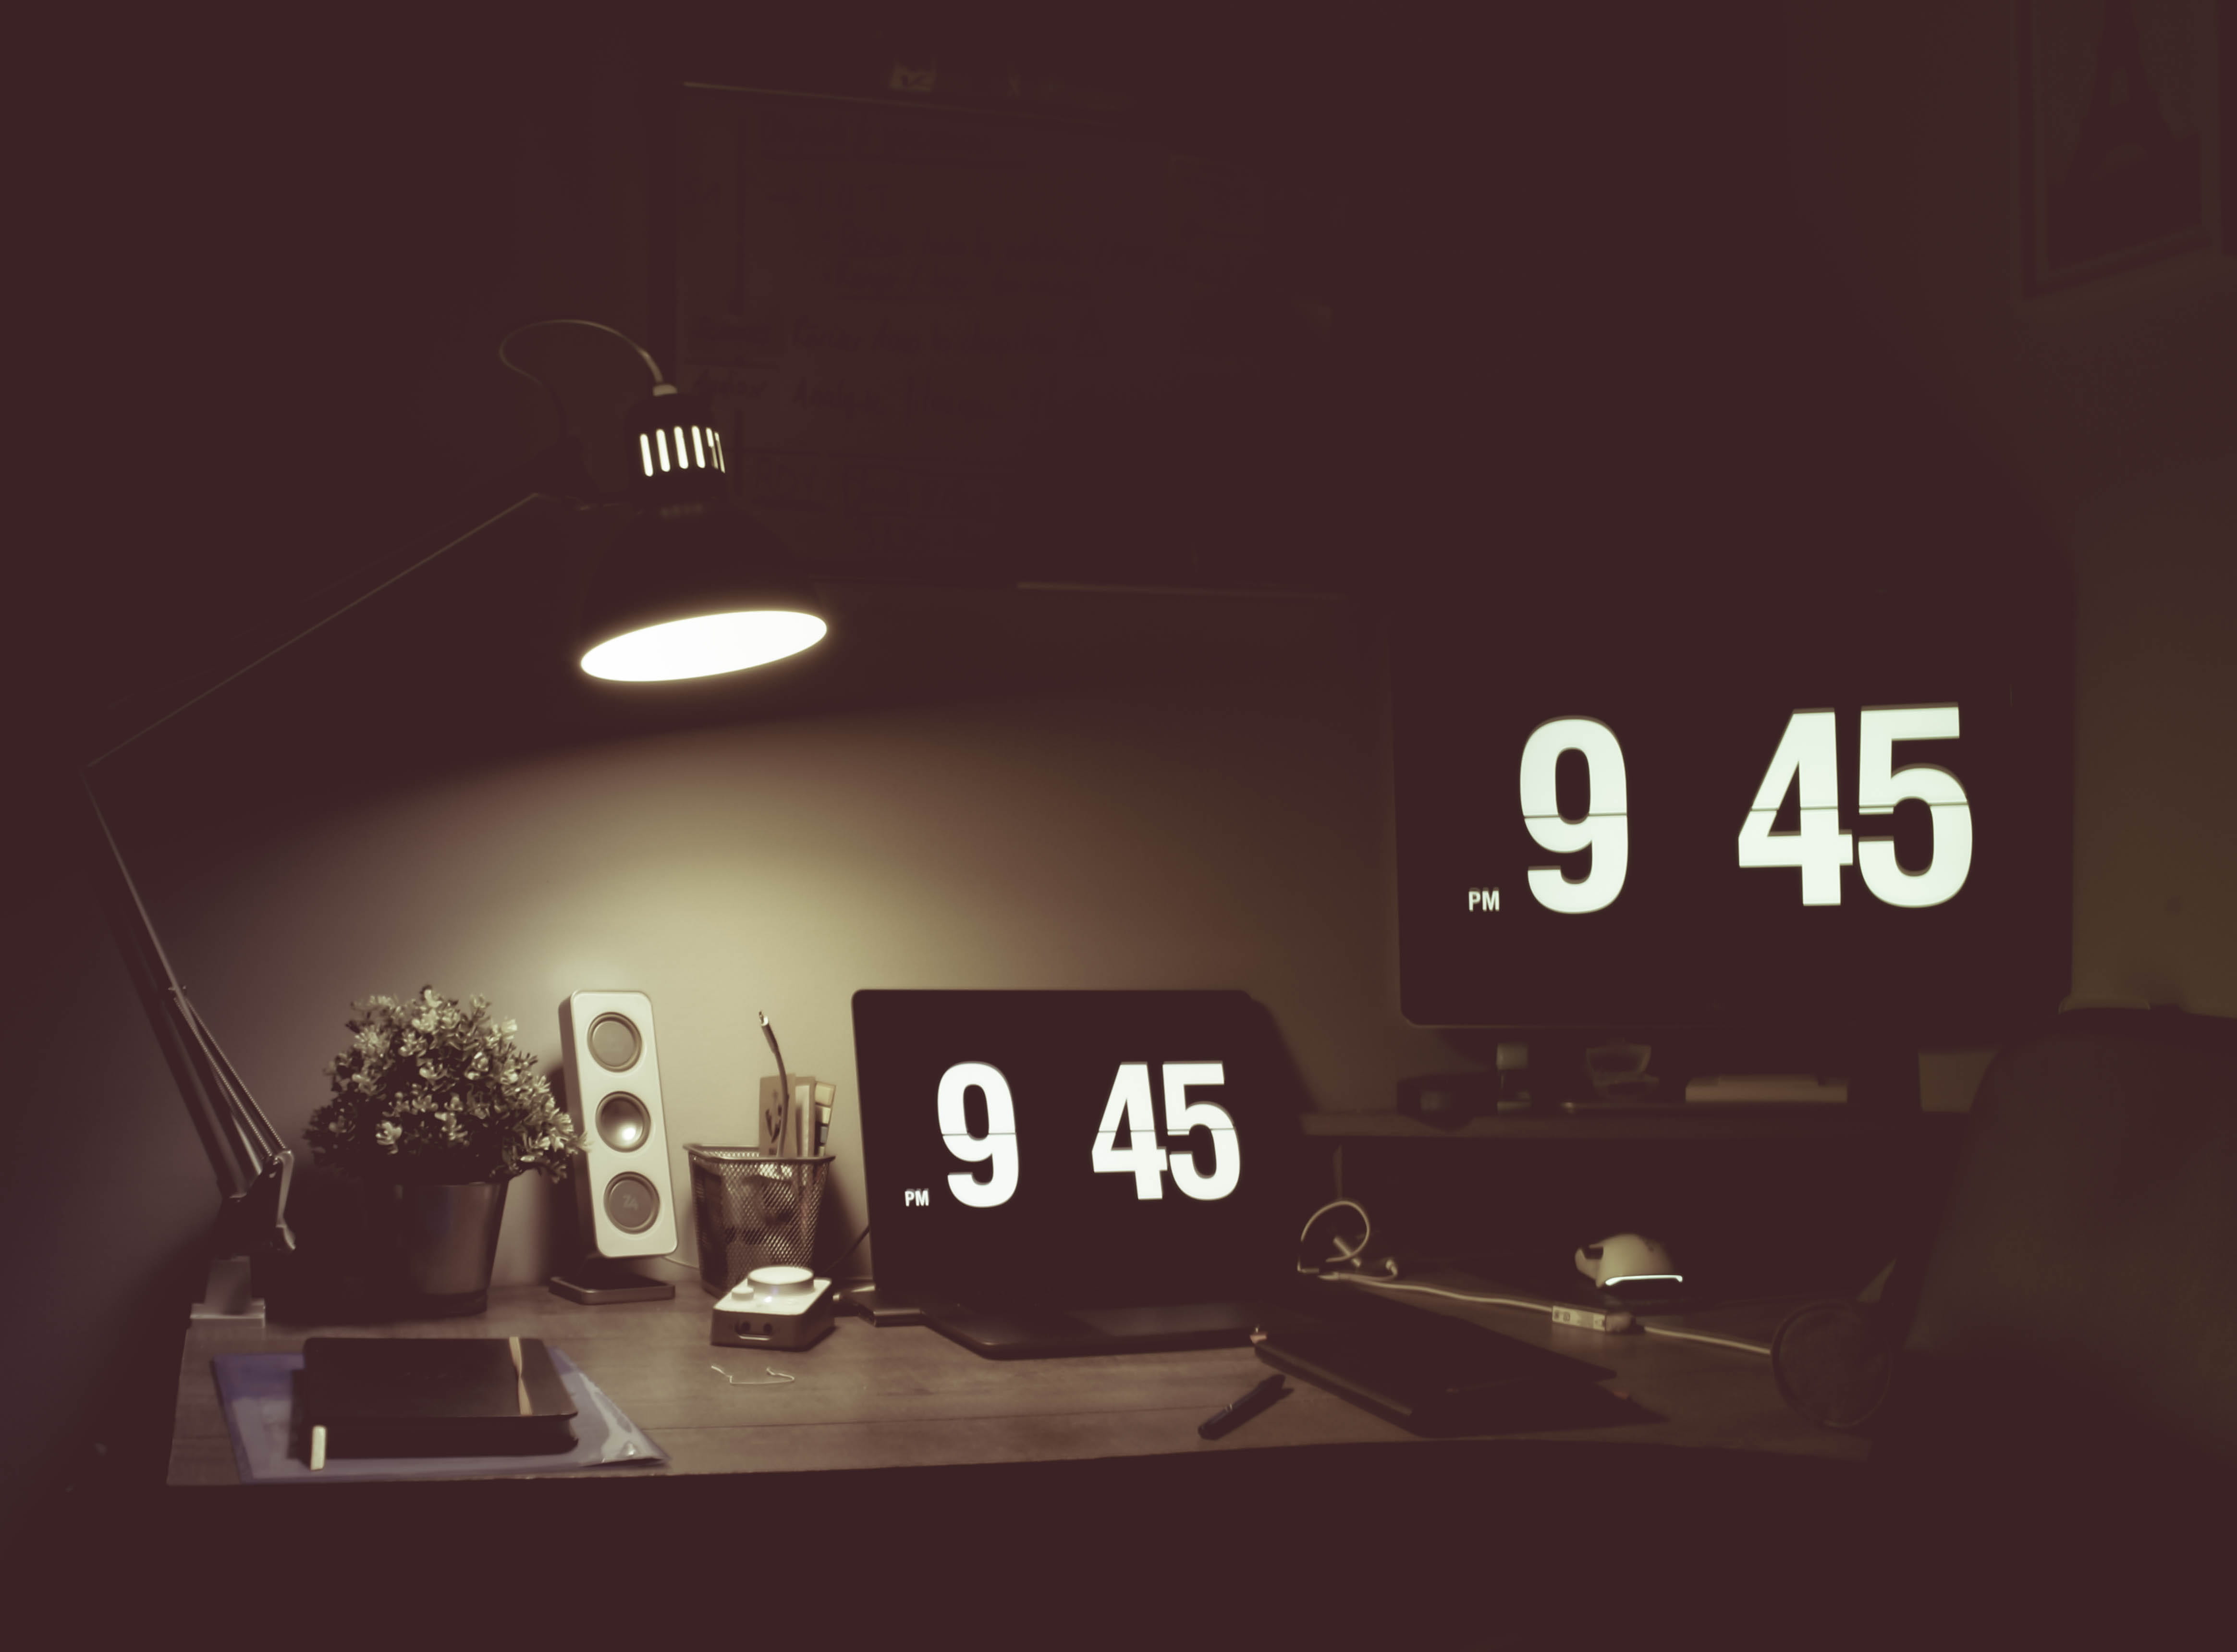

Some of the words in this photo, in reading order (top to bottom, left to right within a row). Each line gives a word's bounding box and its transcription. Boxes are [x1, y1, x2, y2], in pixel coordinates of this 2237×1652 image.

[1468, 889, 1500, 912] PM
[1519, 716, 1629, 915] 9
[1737, 704, 1973, 908] 45
[904, 1188, 930, 1207] PM
[937, 1061, 1019, 1208] 9
[1091, 1060, 1241, 1201] 45
